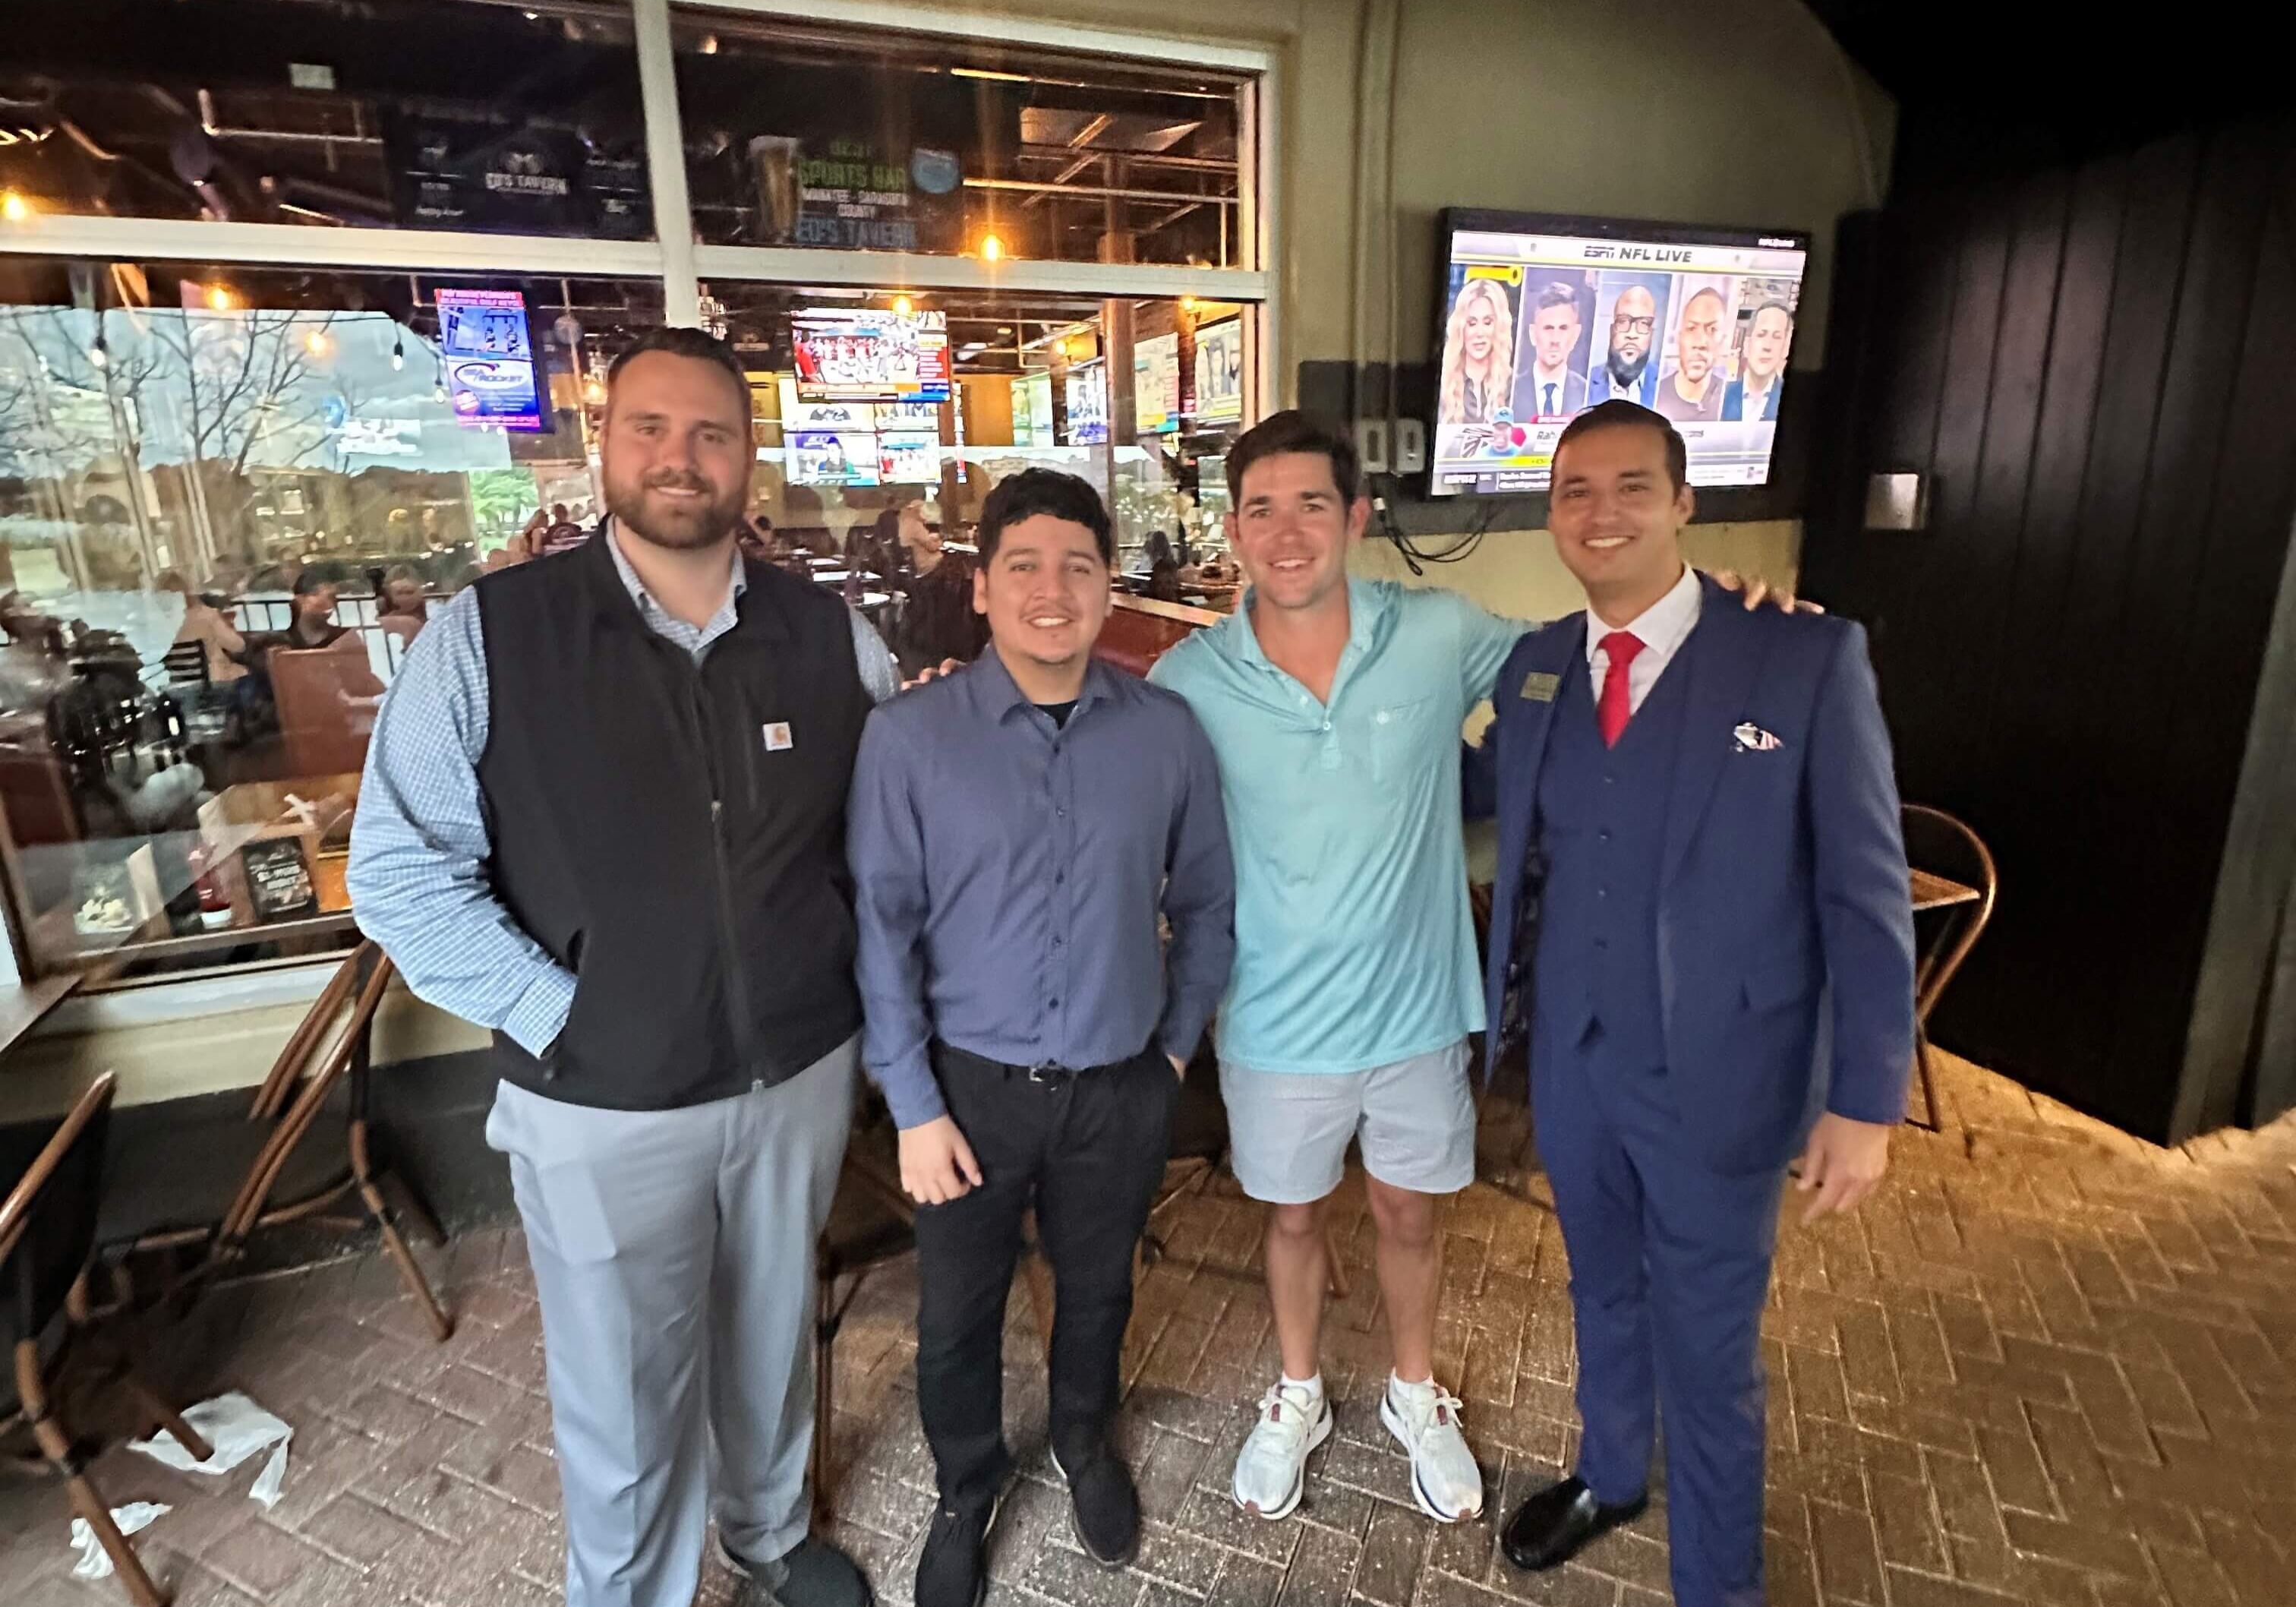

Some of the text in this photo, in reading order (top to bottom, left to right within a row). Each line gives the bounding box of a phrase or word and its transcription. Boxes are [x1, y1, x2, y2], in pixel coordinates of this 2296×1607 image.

[800, 159, 868, 188] SPORTS
[1619, 248, 1651, 260] NFL
[1654, 249, 1692, 263] LIVE
